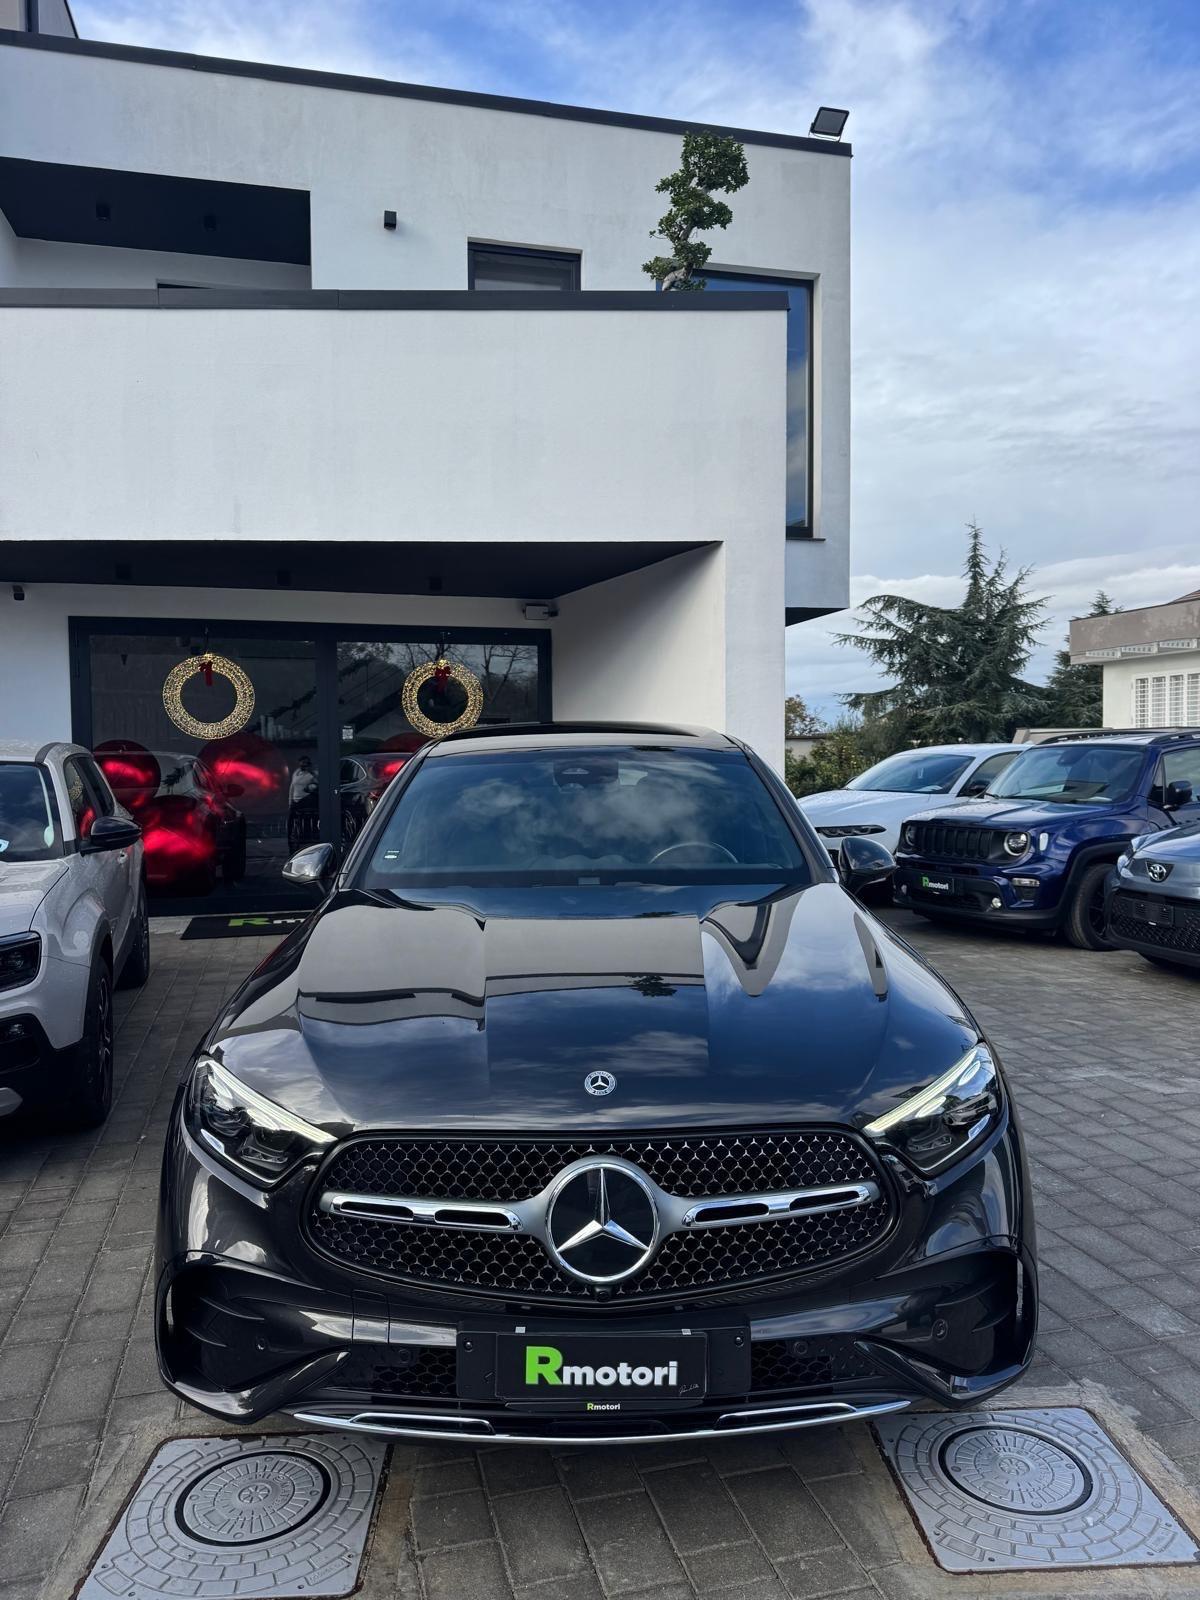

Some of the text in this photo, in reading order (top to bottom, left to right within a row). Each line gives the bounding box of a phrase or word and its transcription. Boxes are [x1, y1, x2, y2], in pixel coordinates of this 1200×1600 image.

[922, 876, 949, 890] Rmotori
[525, 1345, 678, 1386] Rmotori
[586, 1402, 621, 1411] Rmotori
